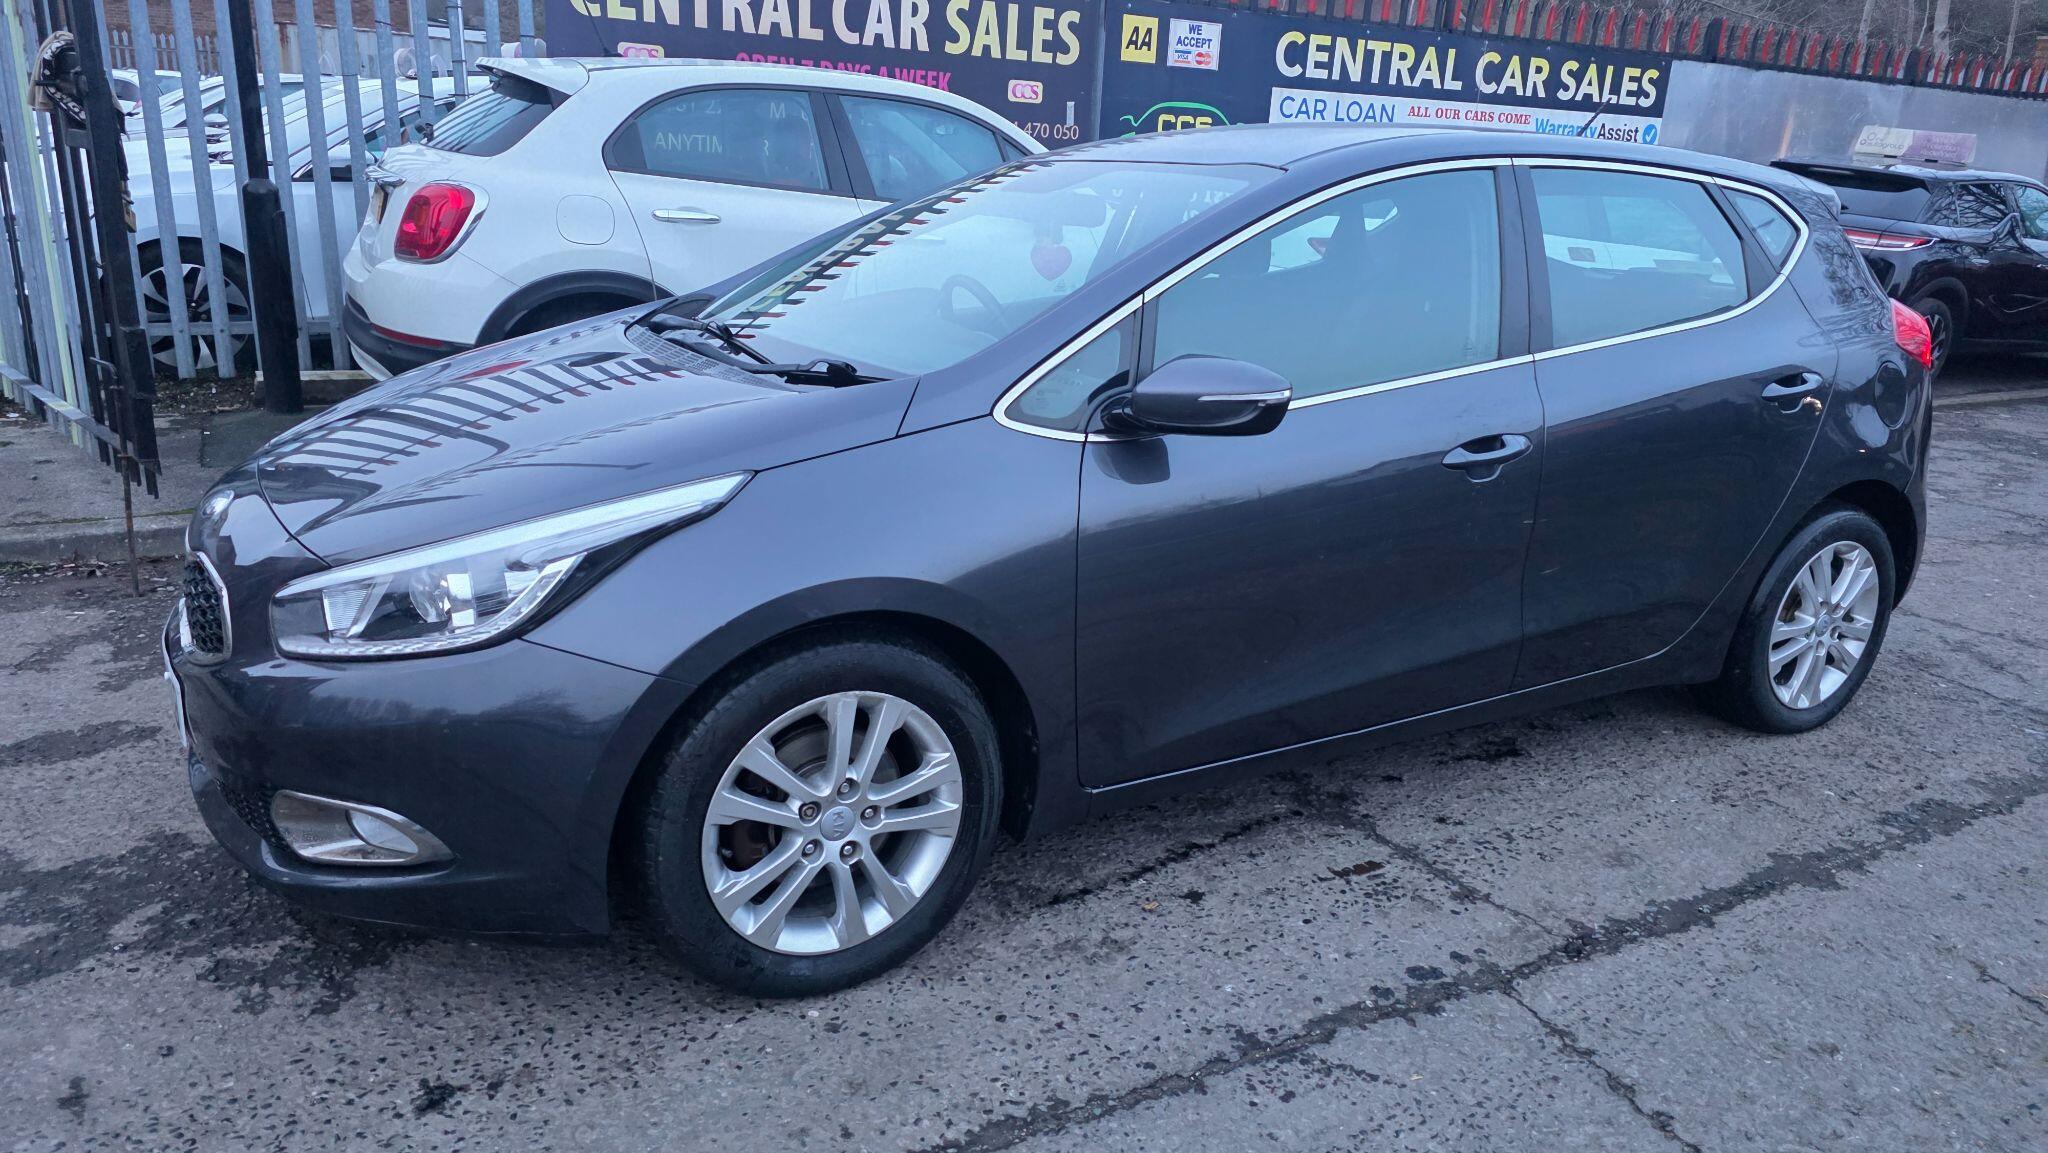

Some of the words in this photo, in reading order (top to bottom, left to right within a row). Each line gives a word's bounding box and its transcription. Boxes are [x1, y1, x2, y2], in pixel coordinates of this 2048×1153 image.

[569, 0, 823, 41] TRAL
[832, 0, 929, 52] CAR
[944, 0, 1081, 65] SALES
[1125, 26, 1153, 51] AA
[1189, 24, 1203, 35] WE
[1176, 36, 1213, 49] ACCEPT
[1276, 31, 1462, 91] CENTRAL
[1475, 51, 1550, 98] CAR
[1556, 60, 1660, 107] SALES
[1279, 96, 1327, 120] CAR
[1334, 100, 1396, 123] LOAN
[1408, 105, 1431, 118] ALL
[1435, 107, 1461, 120] OUR
[1465, 109, 1495, 122] CARS
[1497, 112, 1531, 125] COME
[1054, 124, 1080, 140] 050
